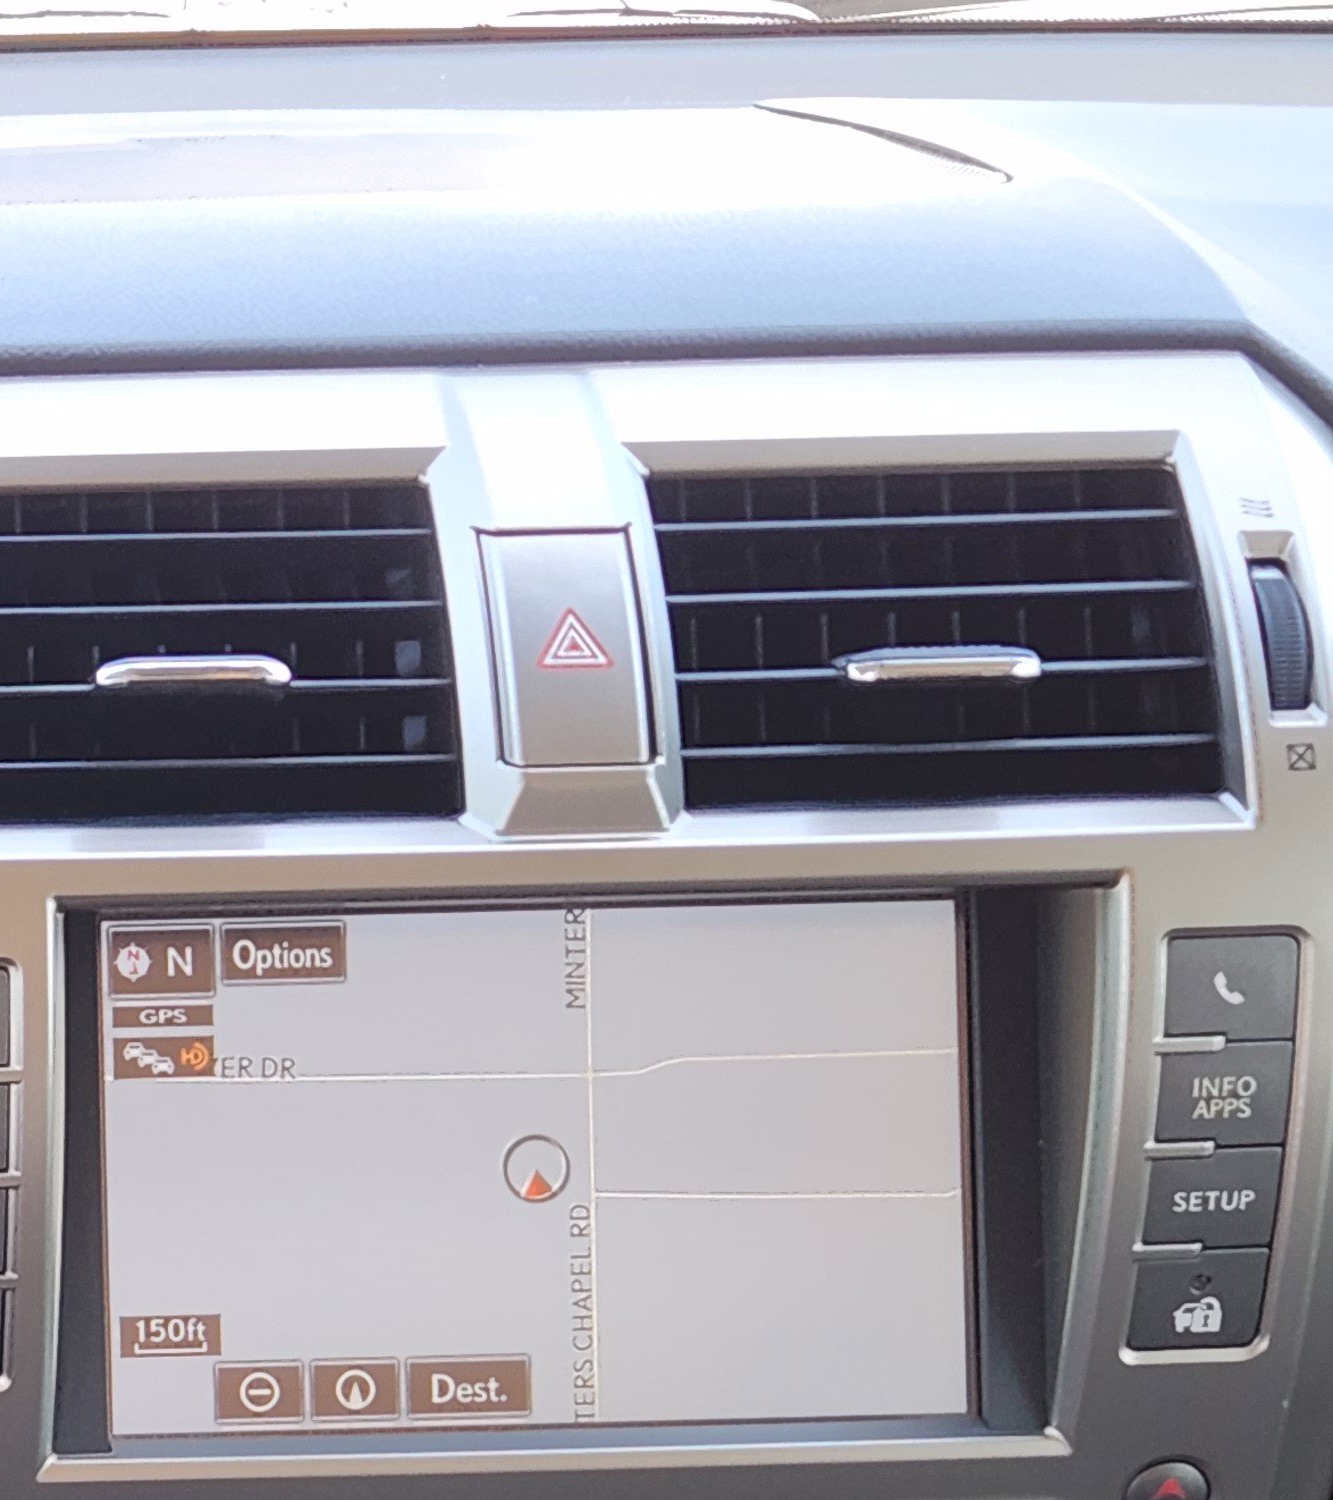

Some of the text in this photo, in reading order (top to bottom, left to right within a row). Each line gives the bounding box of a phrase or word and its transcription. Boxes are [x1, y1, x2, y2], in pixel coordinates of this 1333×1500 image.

[166, 946, 193, 977] N
[232, 940, 334, 976] Options
[564, 909, 586, 1009] MINTER
[138, 1008, 188, 1025] GPS
[261, 1058, 296, 1078] DR
[1192, 1076, 1257, 1097] INFO
[1192, 1099, 1252, 1119] APPS
[1173, 1190, 1256, 1214] SETUP
[569, 1203, 592, 1237] RD
[572, 1242, 596, 1349] CHAPEL
[134, 1319, 207, 1343] 150ft
[431, 1372, 508, 1404] Dest.
